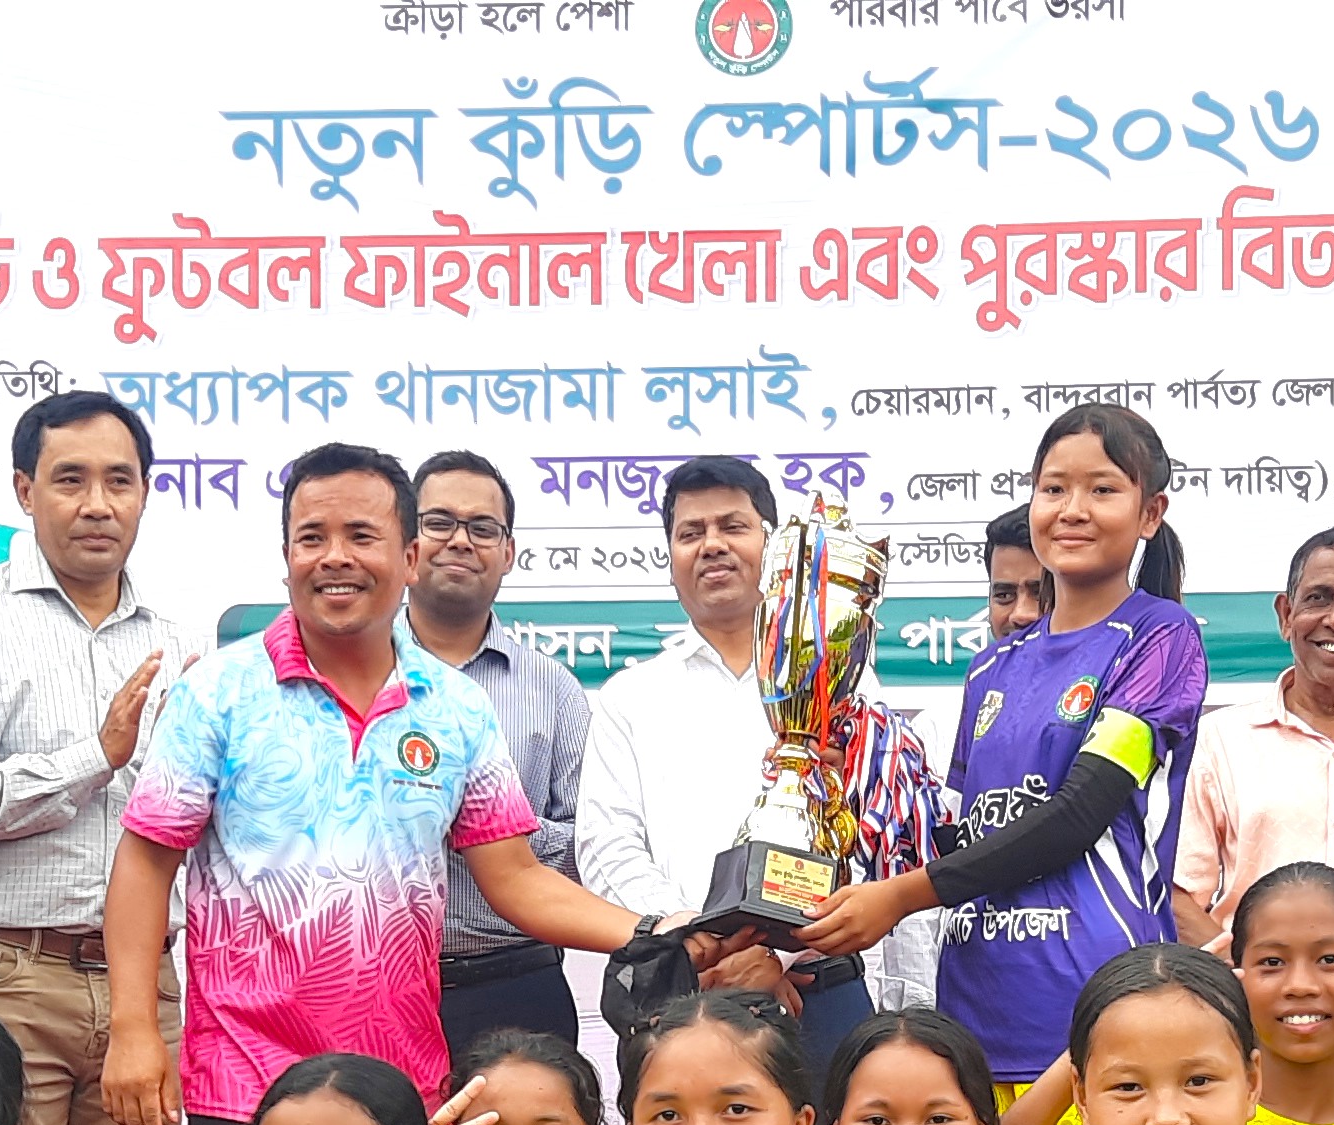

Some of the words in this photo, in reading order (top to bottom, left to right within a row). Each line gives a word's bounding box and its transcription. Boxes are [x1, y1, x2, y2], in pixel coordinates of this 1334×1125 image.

[476, 2, 546, 34] হলে
[556, 0, 635, 32] পেশা
[220, 109, 437, 212] নতুন
[460, 77, 654, 209] কুঁড়ি
[684, 67, 1320, 179] স্পোর্টস-২০২৬
[33, 236, 79, 310] ও
[98, 213, 326, 343] ফুটবল
[340, 210, 602, 318] ফাইনাল
[623, 228, 783, 304] খেলা
[800, 226, 941, 301] এবং
[961, 217, 1202, 332] পুরস্কার
[99, 365, 353, 425] অধ্যাপক
[375, 361, 624, 424] থানজামা
[851, 384, 1011, 420] চেয়ারম্যান,
[1167, 369, 1261, 411] পার্বত্য
[151, 452, 249, 511] নাব
[907, 473, 981, 501] জেলা
[546, 546, 581, 571] মে
[591, 546, 670, 574] ২০২৬
